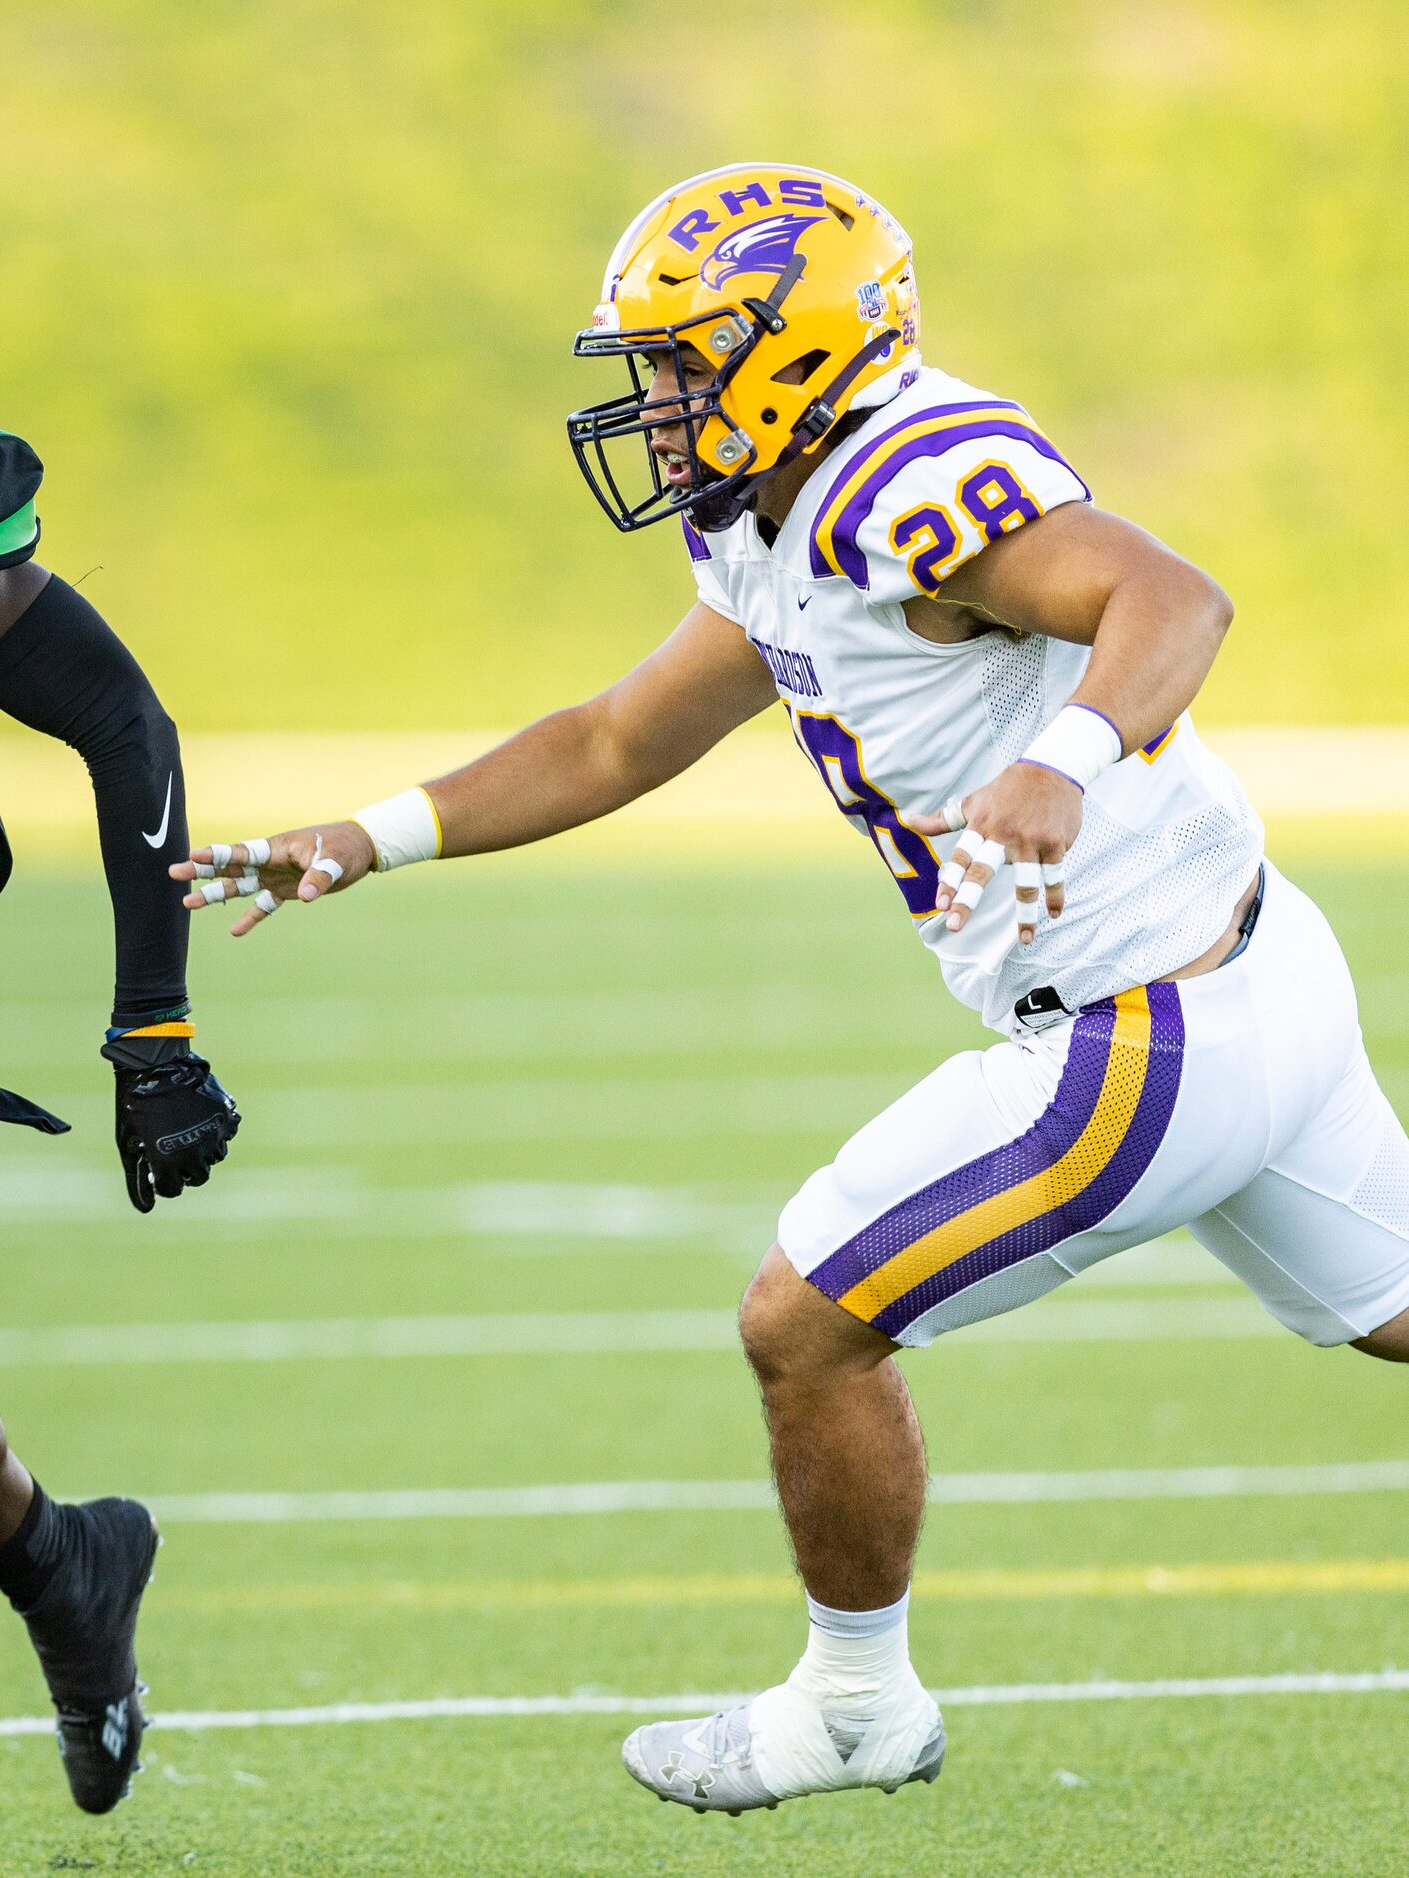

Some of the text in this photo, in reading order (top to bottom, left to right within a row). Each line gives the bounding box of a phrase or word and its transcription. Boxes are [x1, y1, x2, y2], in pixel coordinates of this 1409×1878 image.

[667, 179, 826, 253] RHS
[888, 458, 1046, 599] 28
[1027, 995, 1042, 1010] L
